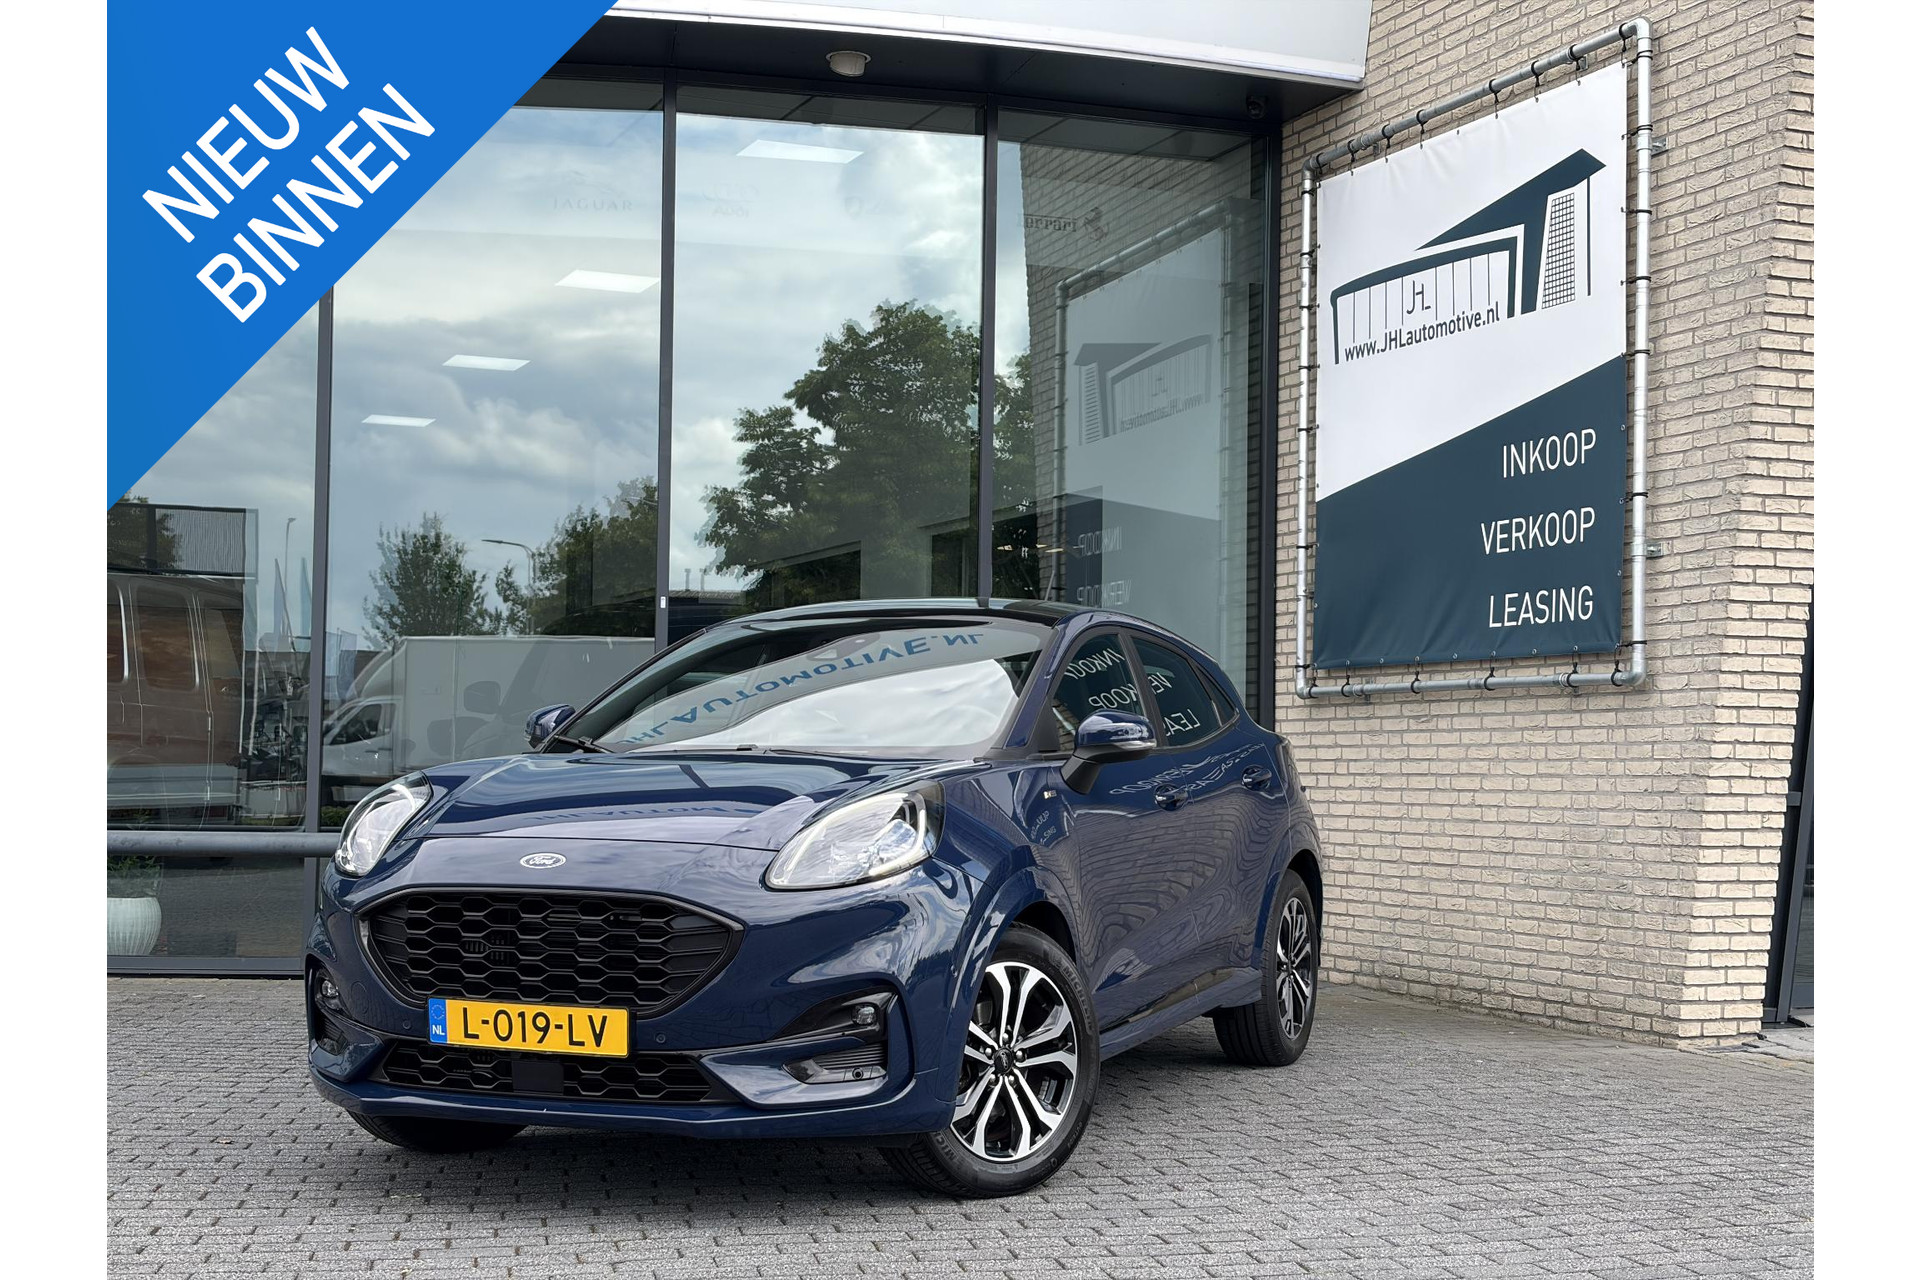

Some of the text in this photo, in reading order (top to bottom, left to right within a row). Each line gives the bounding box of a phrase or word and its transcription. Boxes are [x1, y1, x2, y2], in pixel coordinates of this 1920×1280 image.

[553, 197, 633, 213] JAGUAR
[1344, 301, 1500, 362] www.JHLautomotive.nl
[1503, 428, 1597, 478] INKOOP
[1481, 506, 1596, 555] VERKOOP
[1489, 585, 1594, 628] LEASING
[432, 1025, 445, 1036] NL
[462, 1007, 608, 1048] L-019-LV
